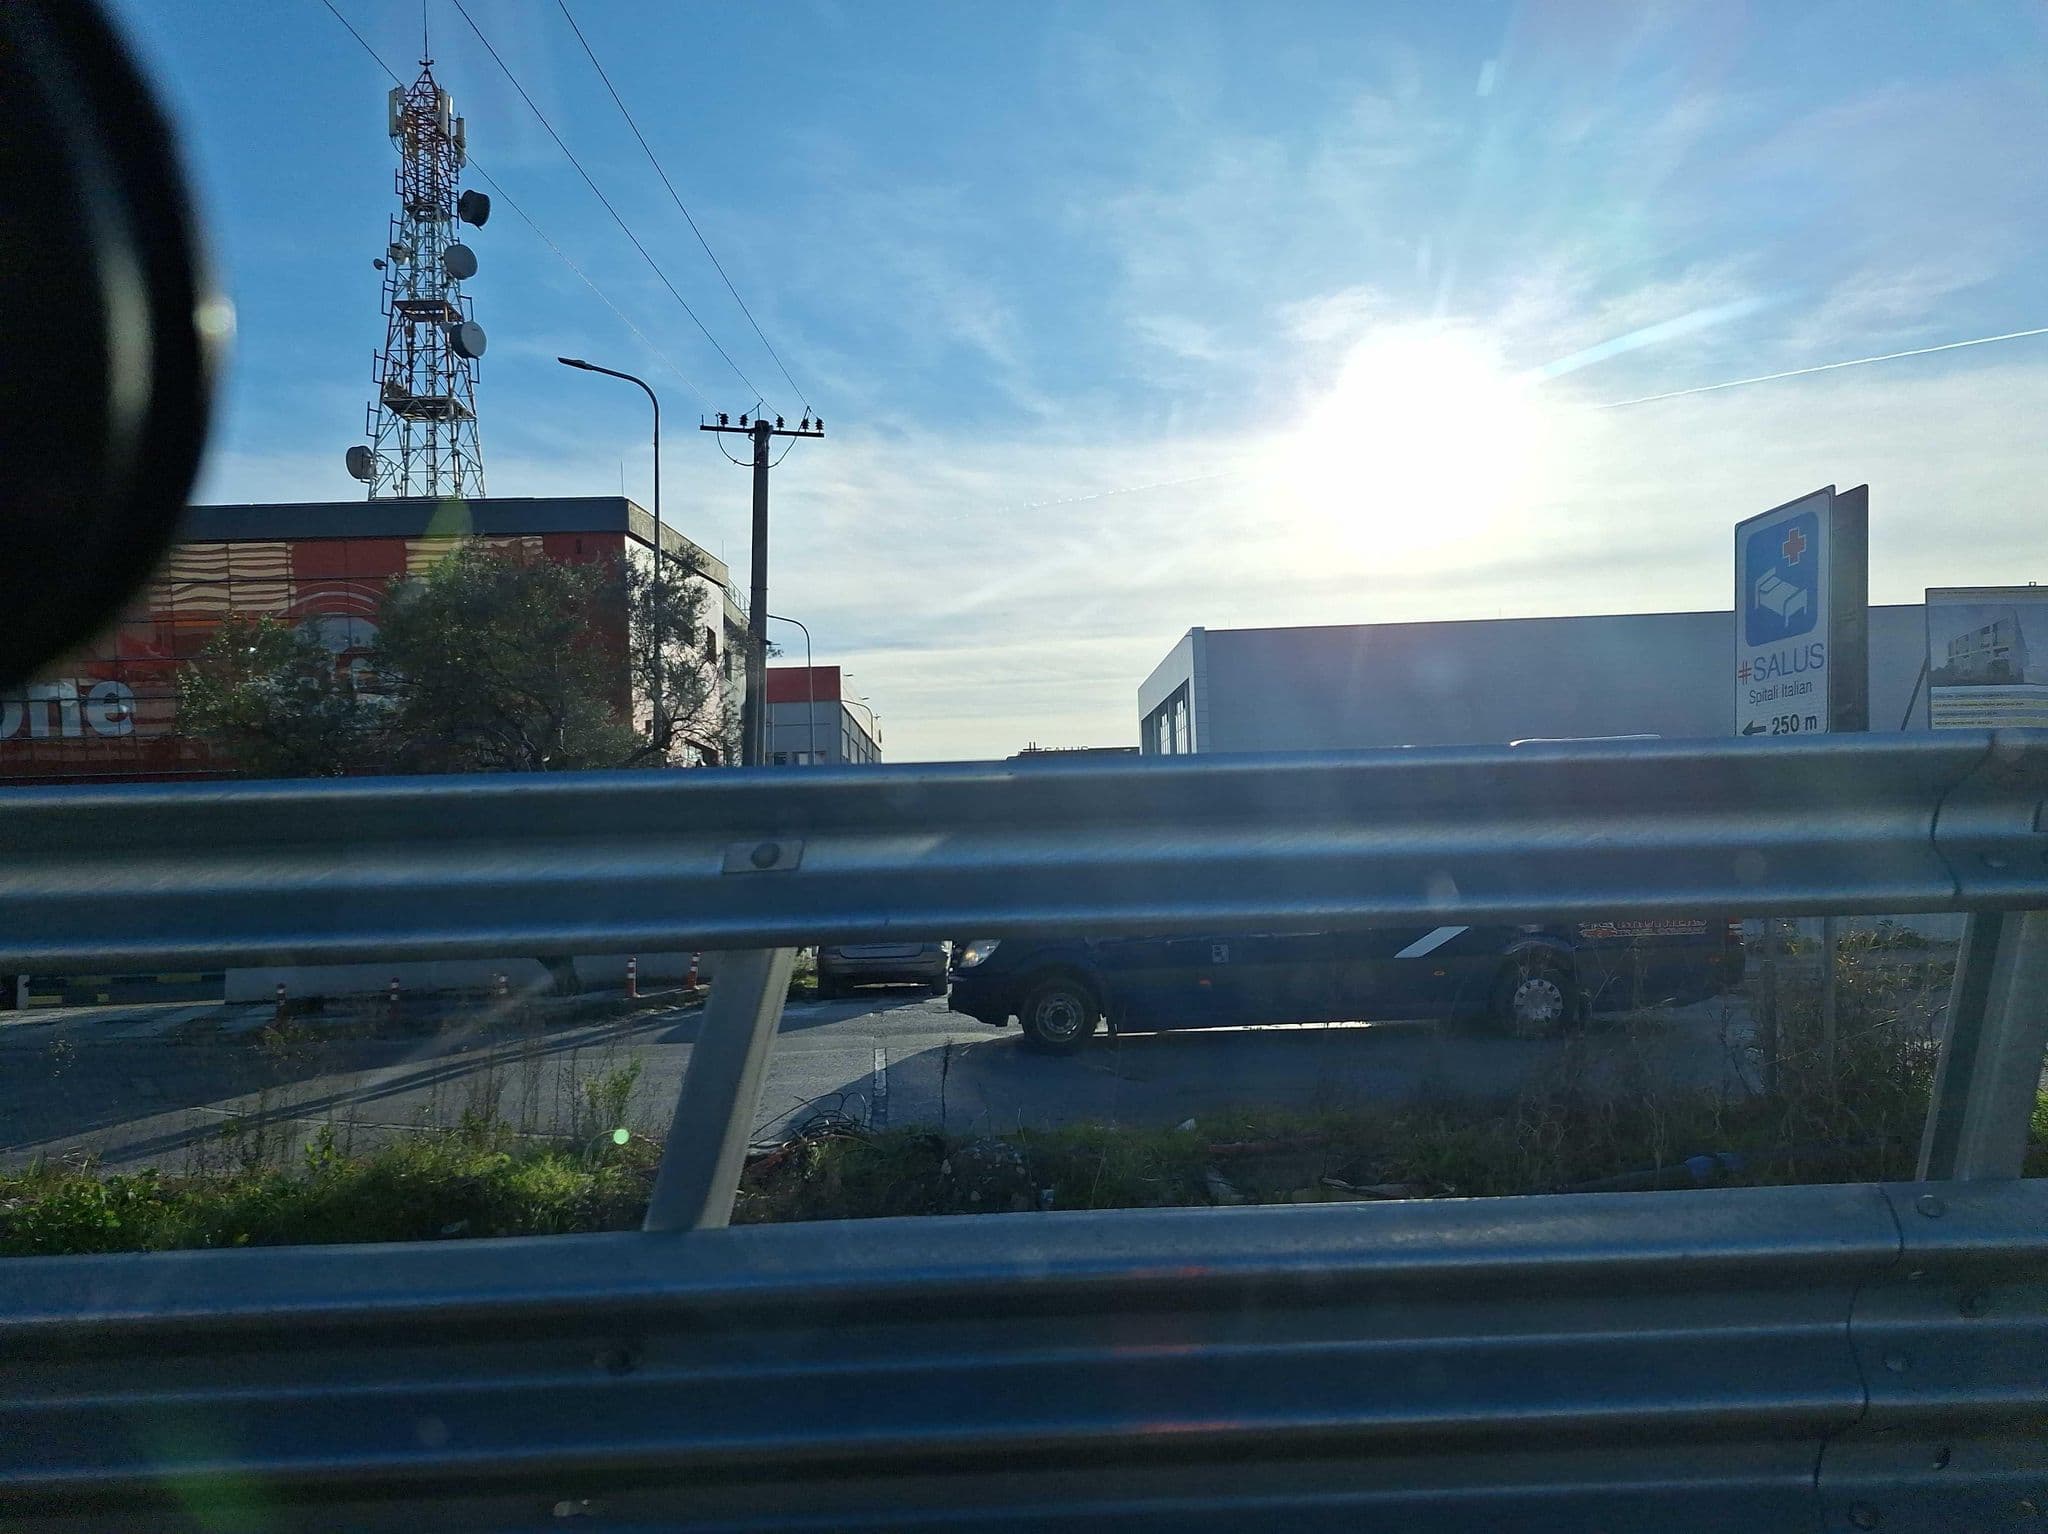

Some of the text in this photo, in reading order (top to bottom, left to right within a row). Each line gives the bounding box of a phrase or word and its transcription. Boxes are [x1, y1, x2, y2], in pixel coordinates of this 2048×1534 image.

[1738, 643, 1825, 685] #SALUS
[1749, 681, 1813, 706] Spitali Italian
[1772, 714, 1817, 735] 250 m
